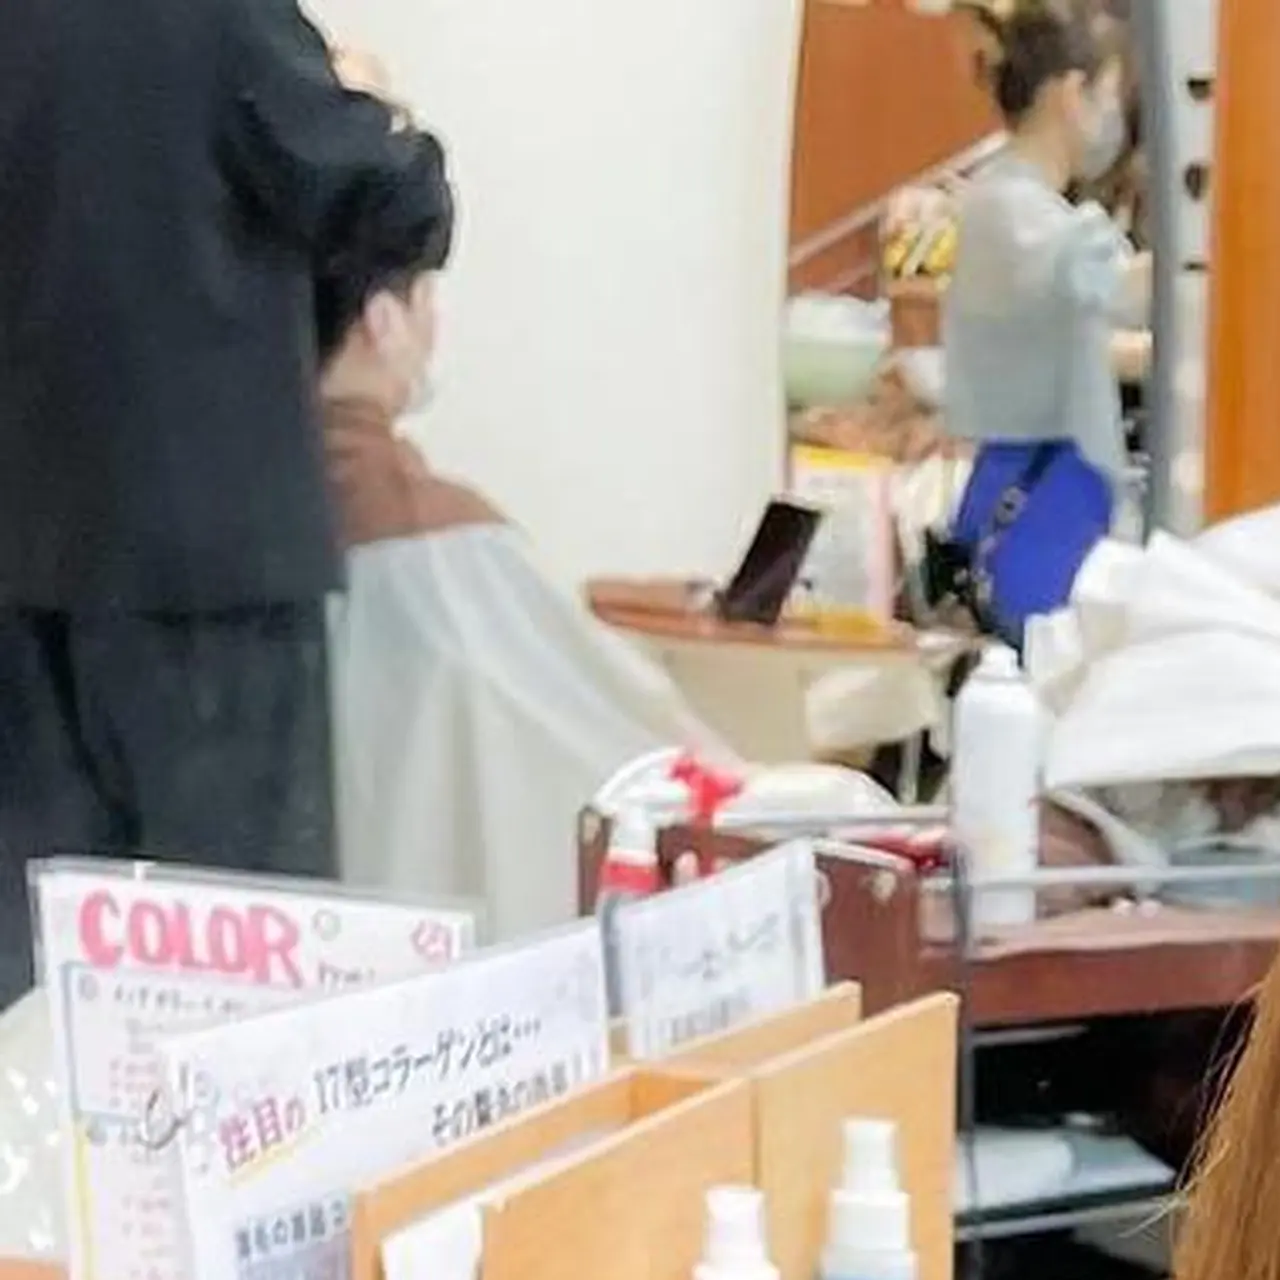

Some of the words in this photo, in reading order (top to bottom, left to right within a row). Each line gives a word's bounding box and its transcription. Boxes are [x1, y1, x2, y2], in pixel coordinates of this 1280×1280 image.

[78, 888, 304, 989] COLOR
[218, 1095, 306, 1171] 注目の
